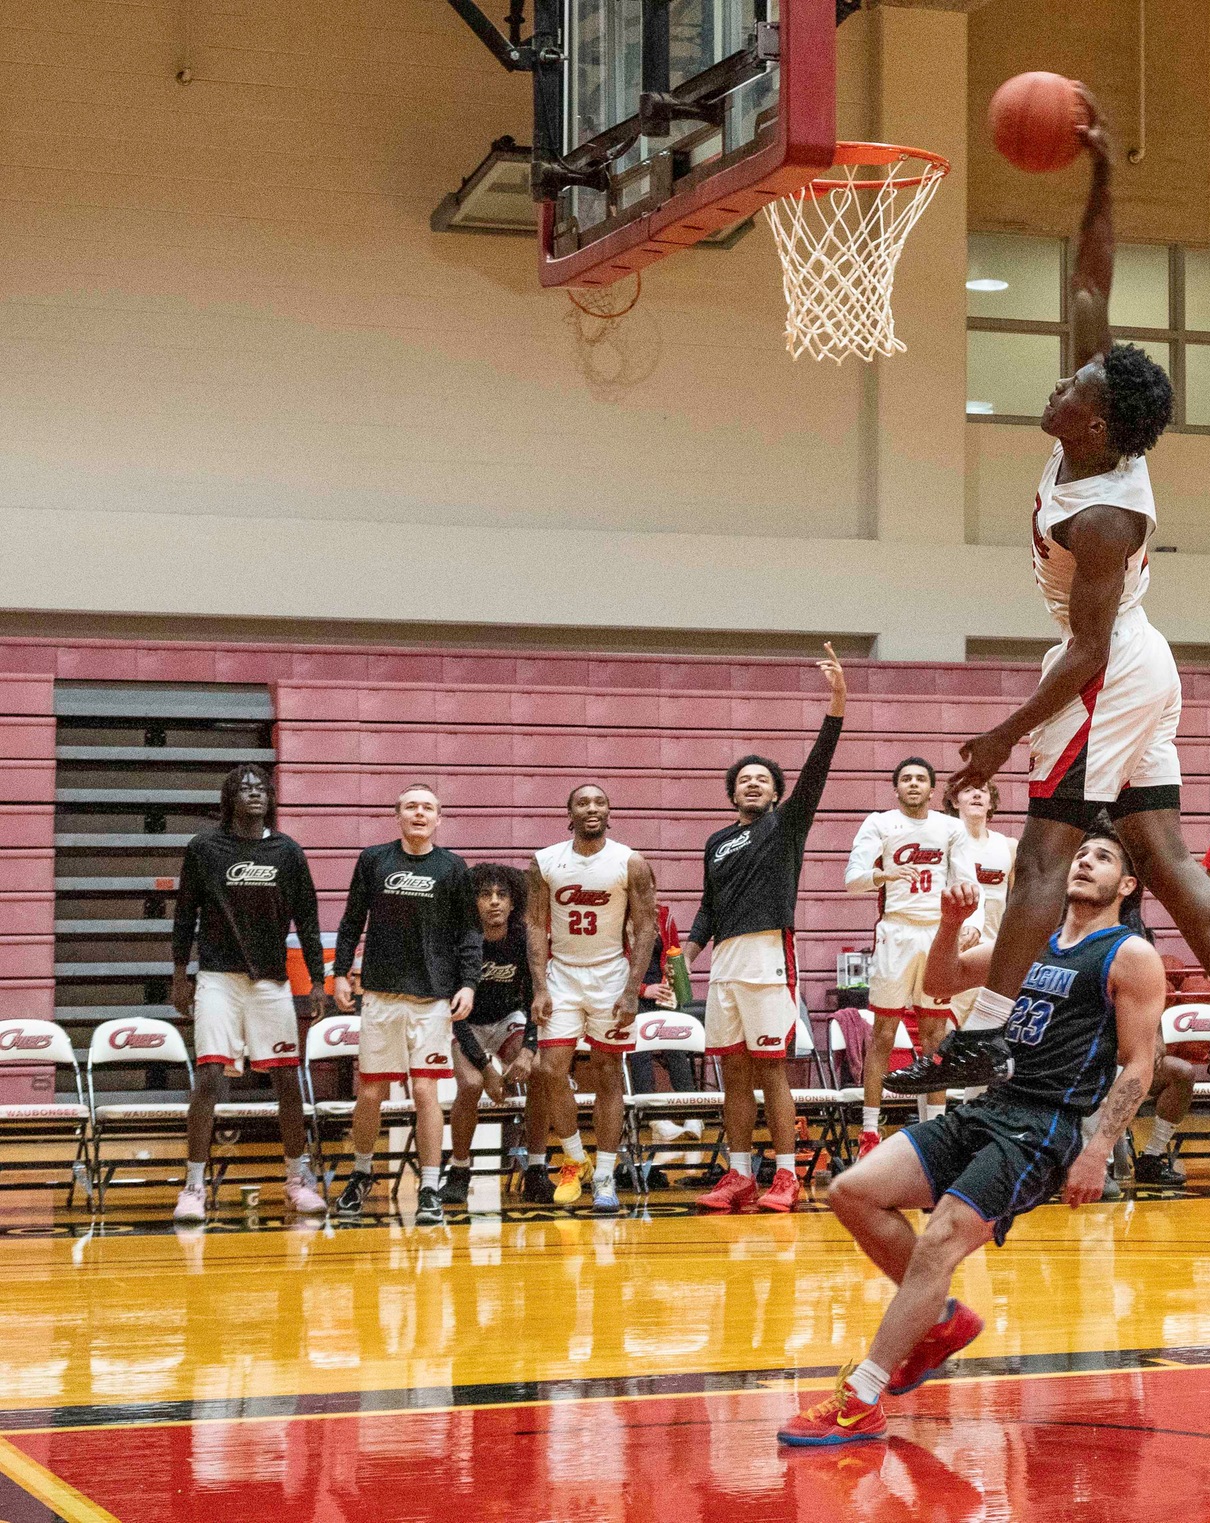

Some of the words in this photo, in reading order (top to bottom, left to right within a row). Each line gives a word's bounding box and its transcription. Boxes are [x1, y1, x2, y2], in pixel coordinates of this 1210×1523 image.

[226, 861, 277, 881] CHIEFS
[384, 870, 436, 892] CHIEFS
[910, 869, 933, 894] 10
[568, 910, 597, 935] 23
[1021, 961, 1079, 998] LGIN
[1004, 996, 1055, 1046] 23
